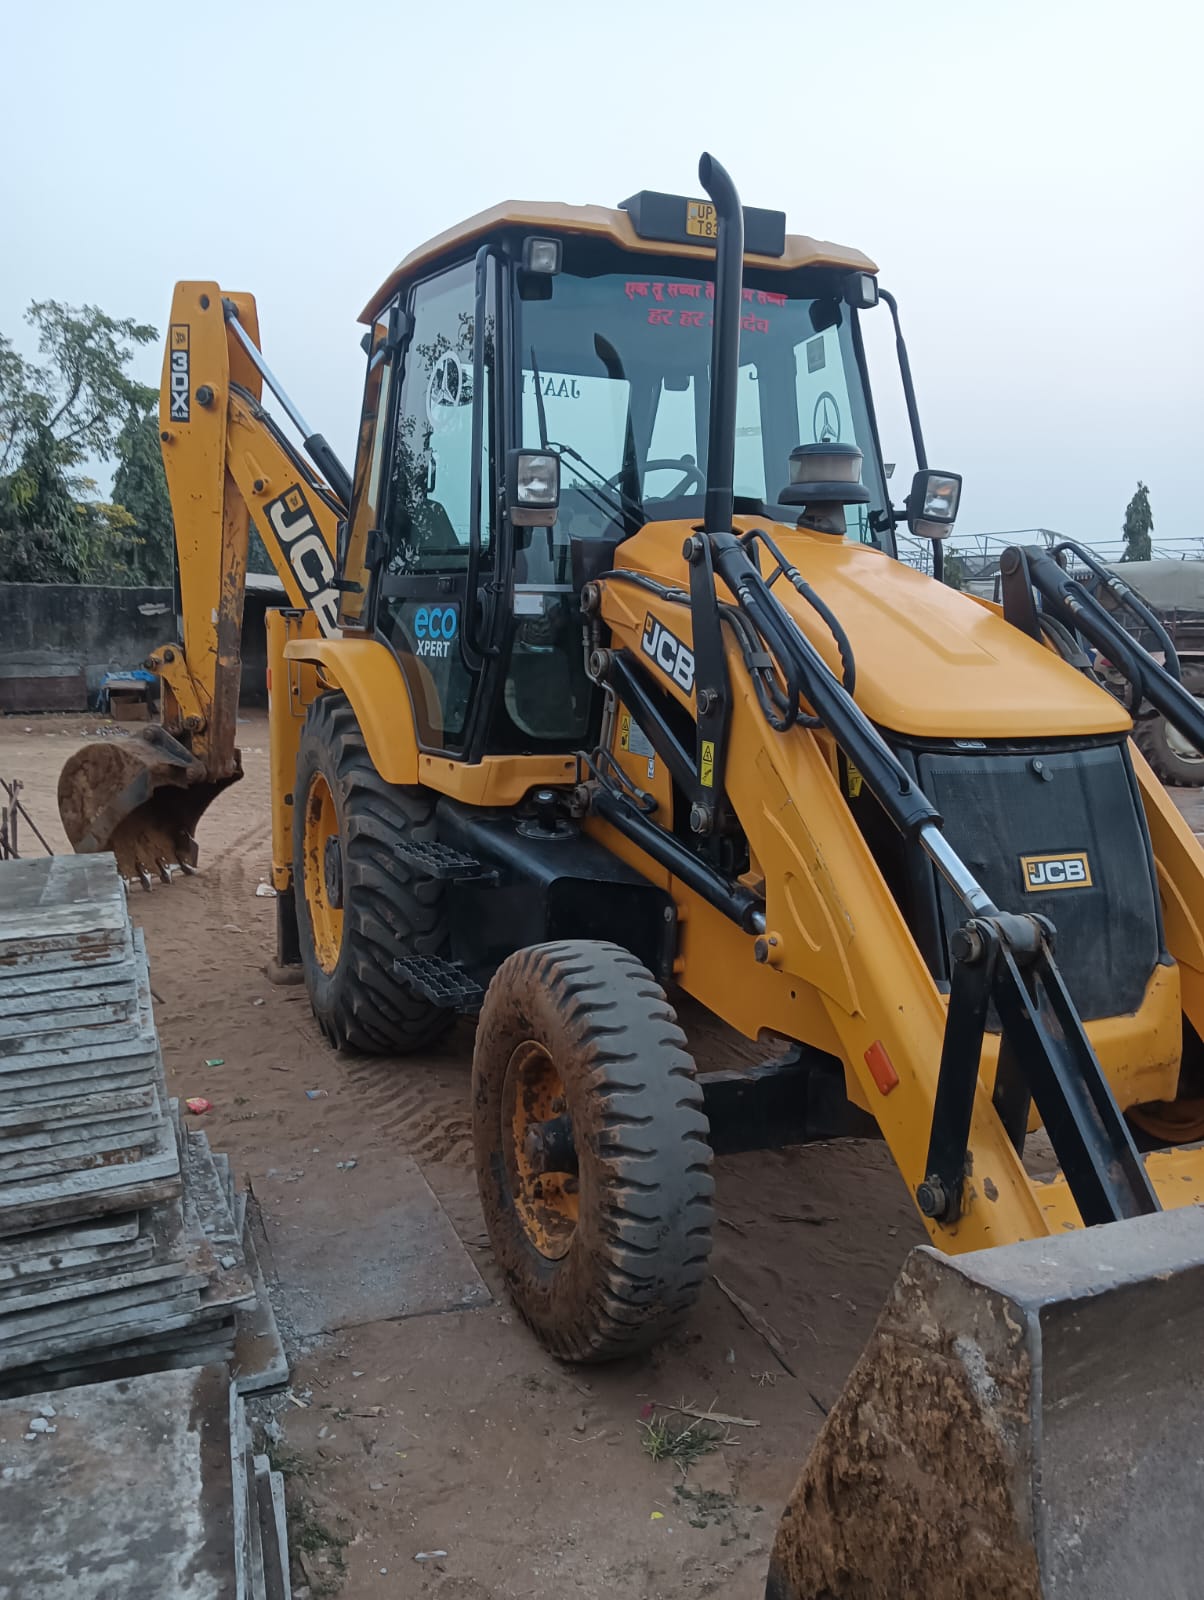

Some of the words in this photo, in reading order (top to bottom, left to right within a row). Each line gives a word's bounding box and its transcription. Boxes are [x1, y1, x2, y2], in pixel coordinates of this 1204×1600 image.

[647, 308, 674, 325] हर
[679, 310, 705, 327] हर
[171, 351, 189, 410] 3DX
[270, 499, 344, 640] JCB
[414, 607, 457, 639] eco
[416, 639, 451, 658] XPERT
[642, 622, 695, 691] JCB
[1030, 860, 1086, 884] JCB
